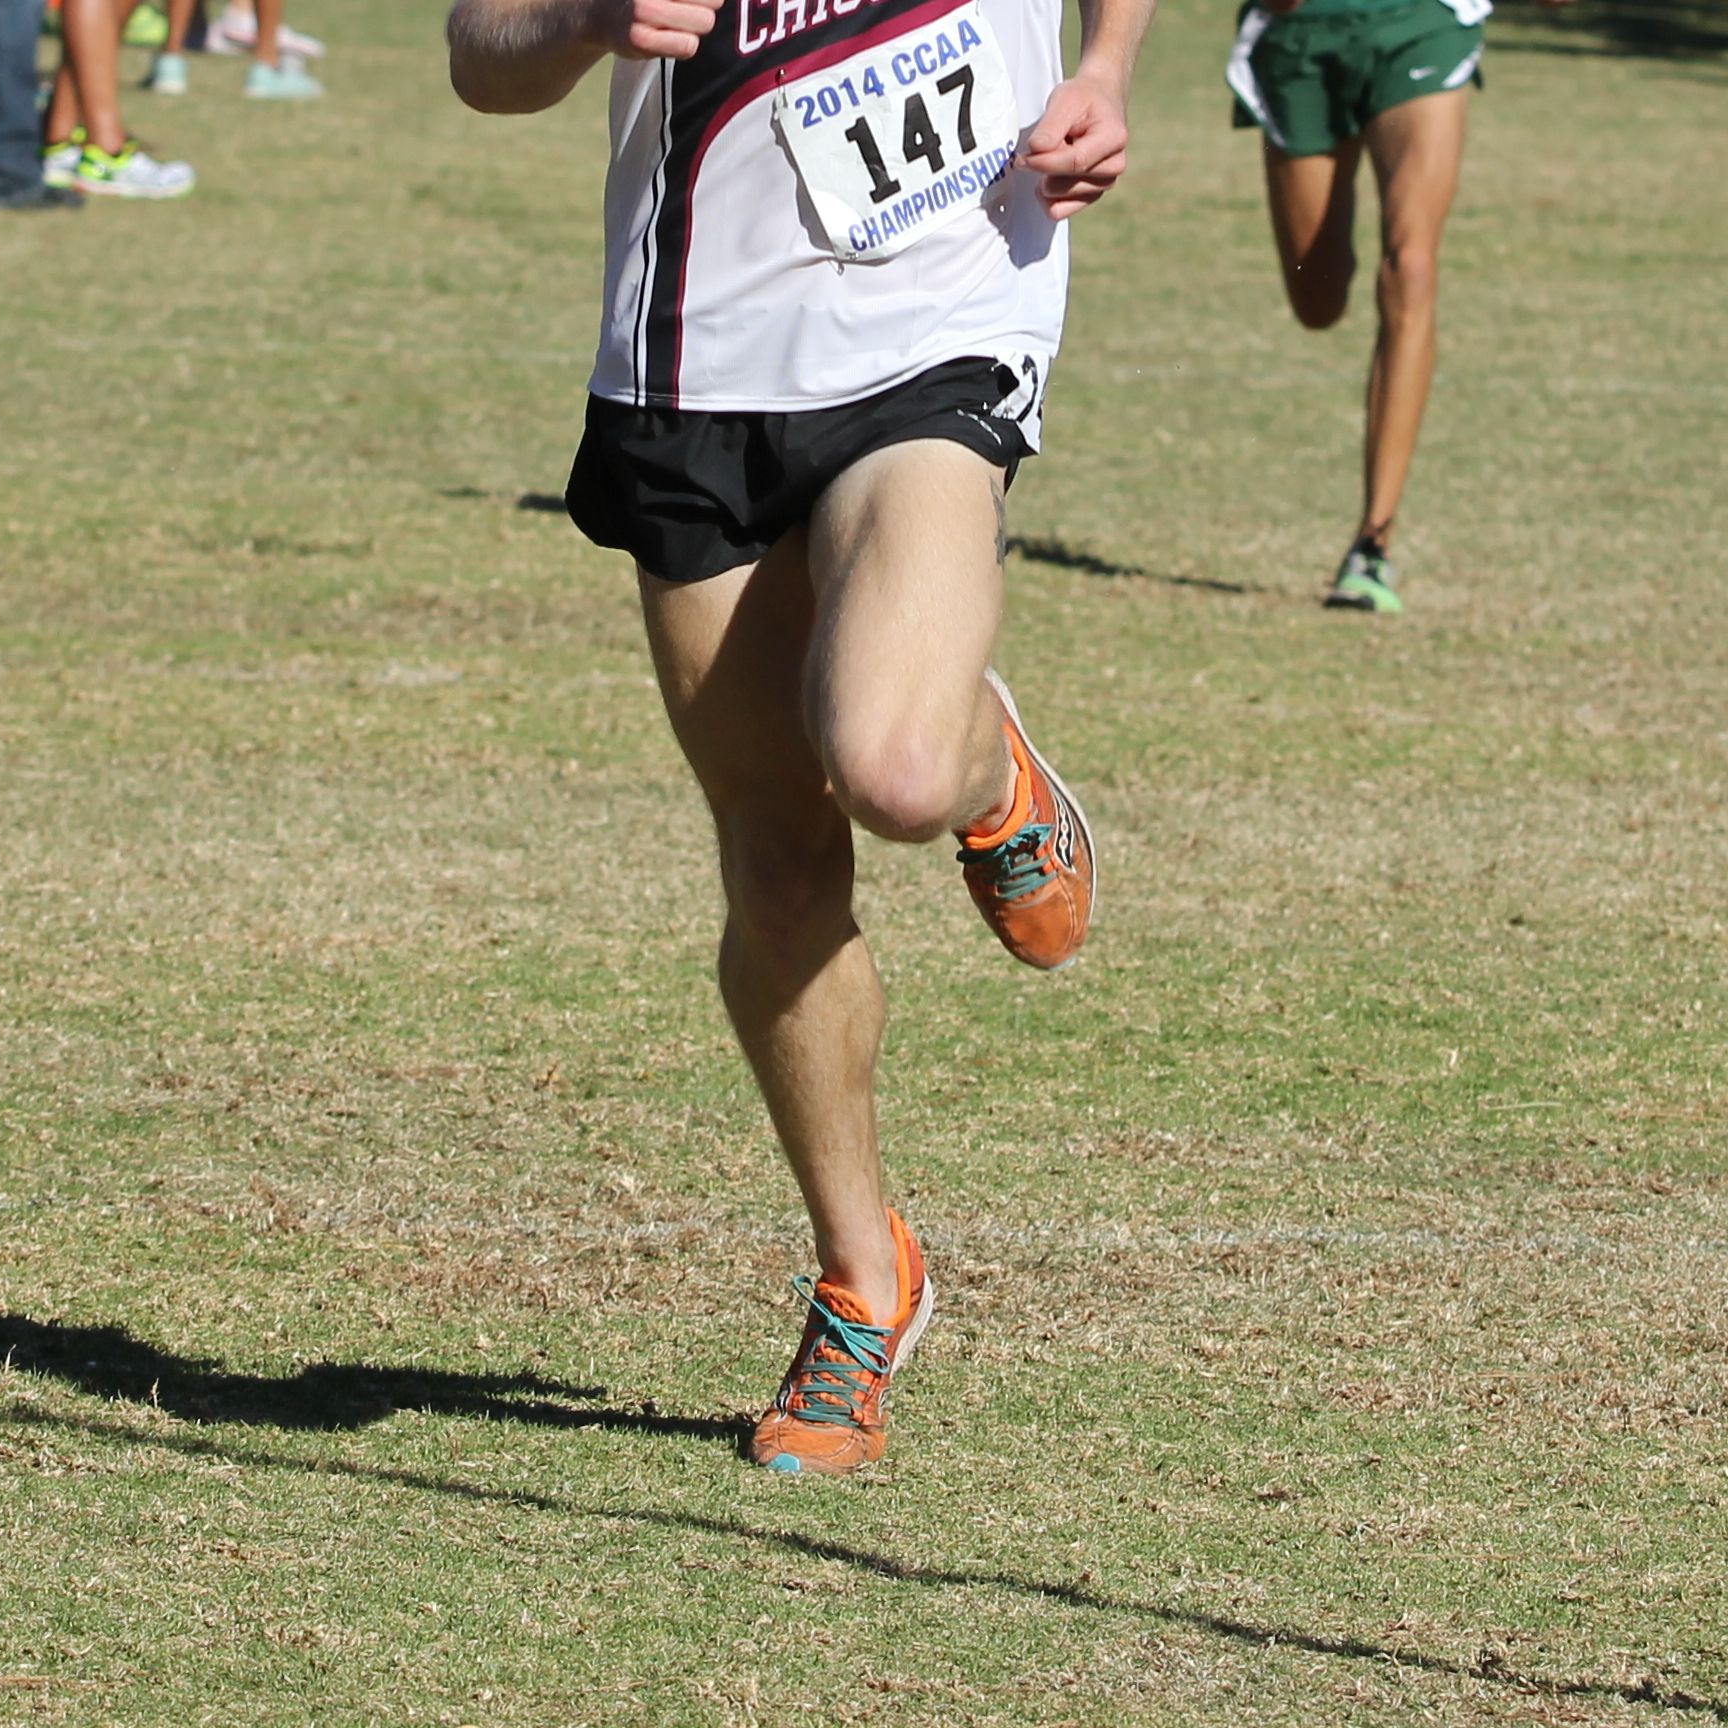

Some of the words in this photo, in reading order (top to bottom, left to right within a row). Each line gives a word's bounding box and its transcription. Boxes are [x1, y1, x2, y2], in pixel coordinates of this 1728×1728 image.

[794, 66, 885, 129] 2014
[891, 19, 983, 87] CCAA
[844, 63, 978, 205] 147
